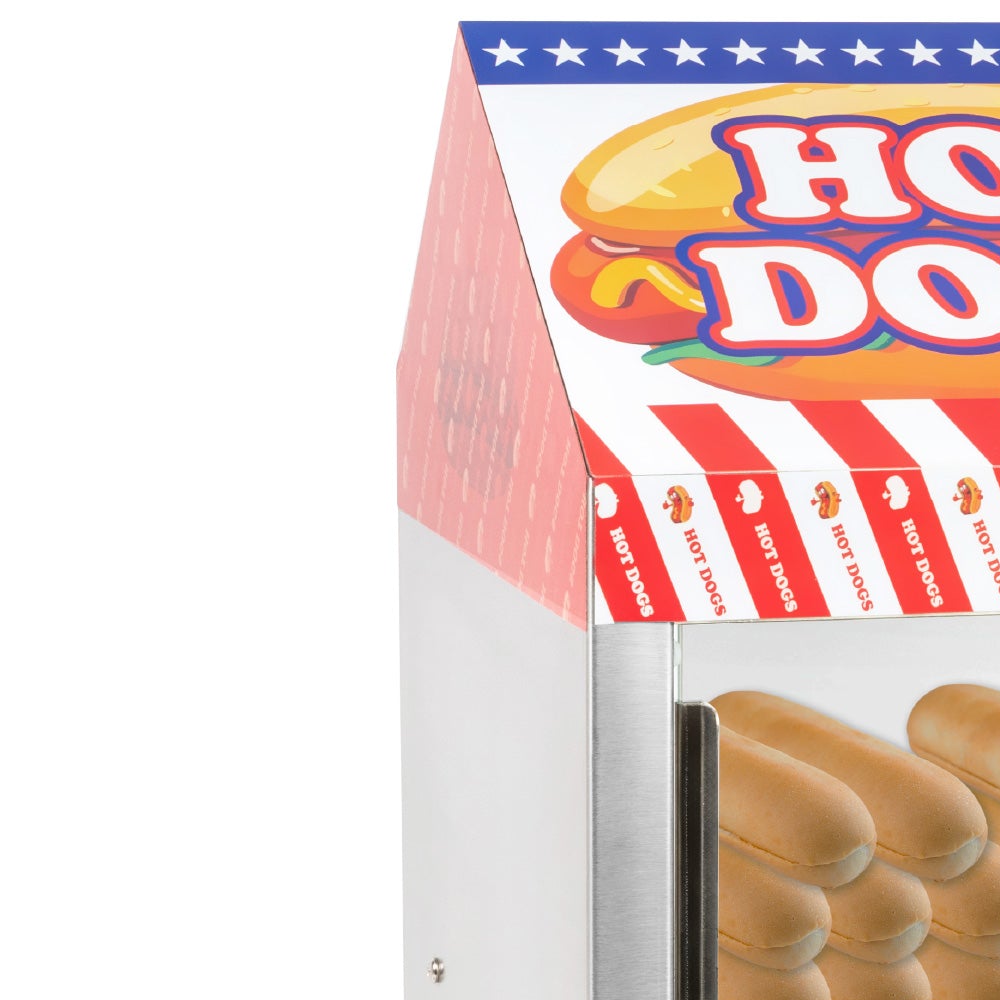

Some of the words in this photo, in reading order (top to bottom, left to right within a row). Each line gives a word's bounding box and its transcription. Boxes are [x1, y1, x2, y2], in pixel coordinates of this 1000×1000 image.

[610, 527, 634, 564] HOT
[626, 567, 654, 618] DOGS
[684, 528, 707, 564] HOT
[699, 566, 727, 617] DOGS
[755, 523, 778, 559] HOT
[770, 562, 797, 612] DOGS
[831, 524, 854, 559] HOT
[846, 561, 873, 611] DOGS
[902, 518, 924, 555] HOT
[916, 557, 943, 608] DOGS
[973, 520, 995, 555] HOT
